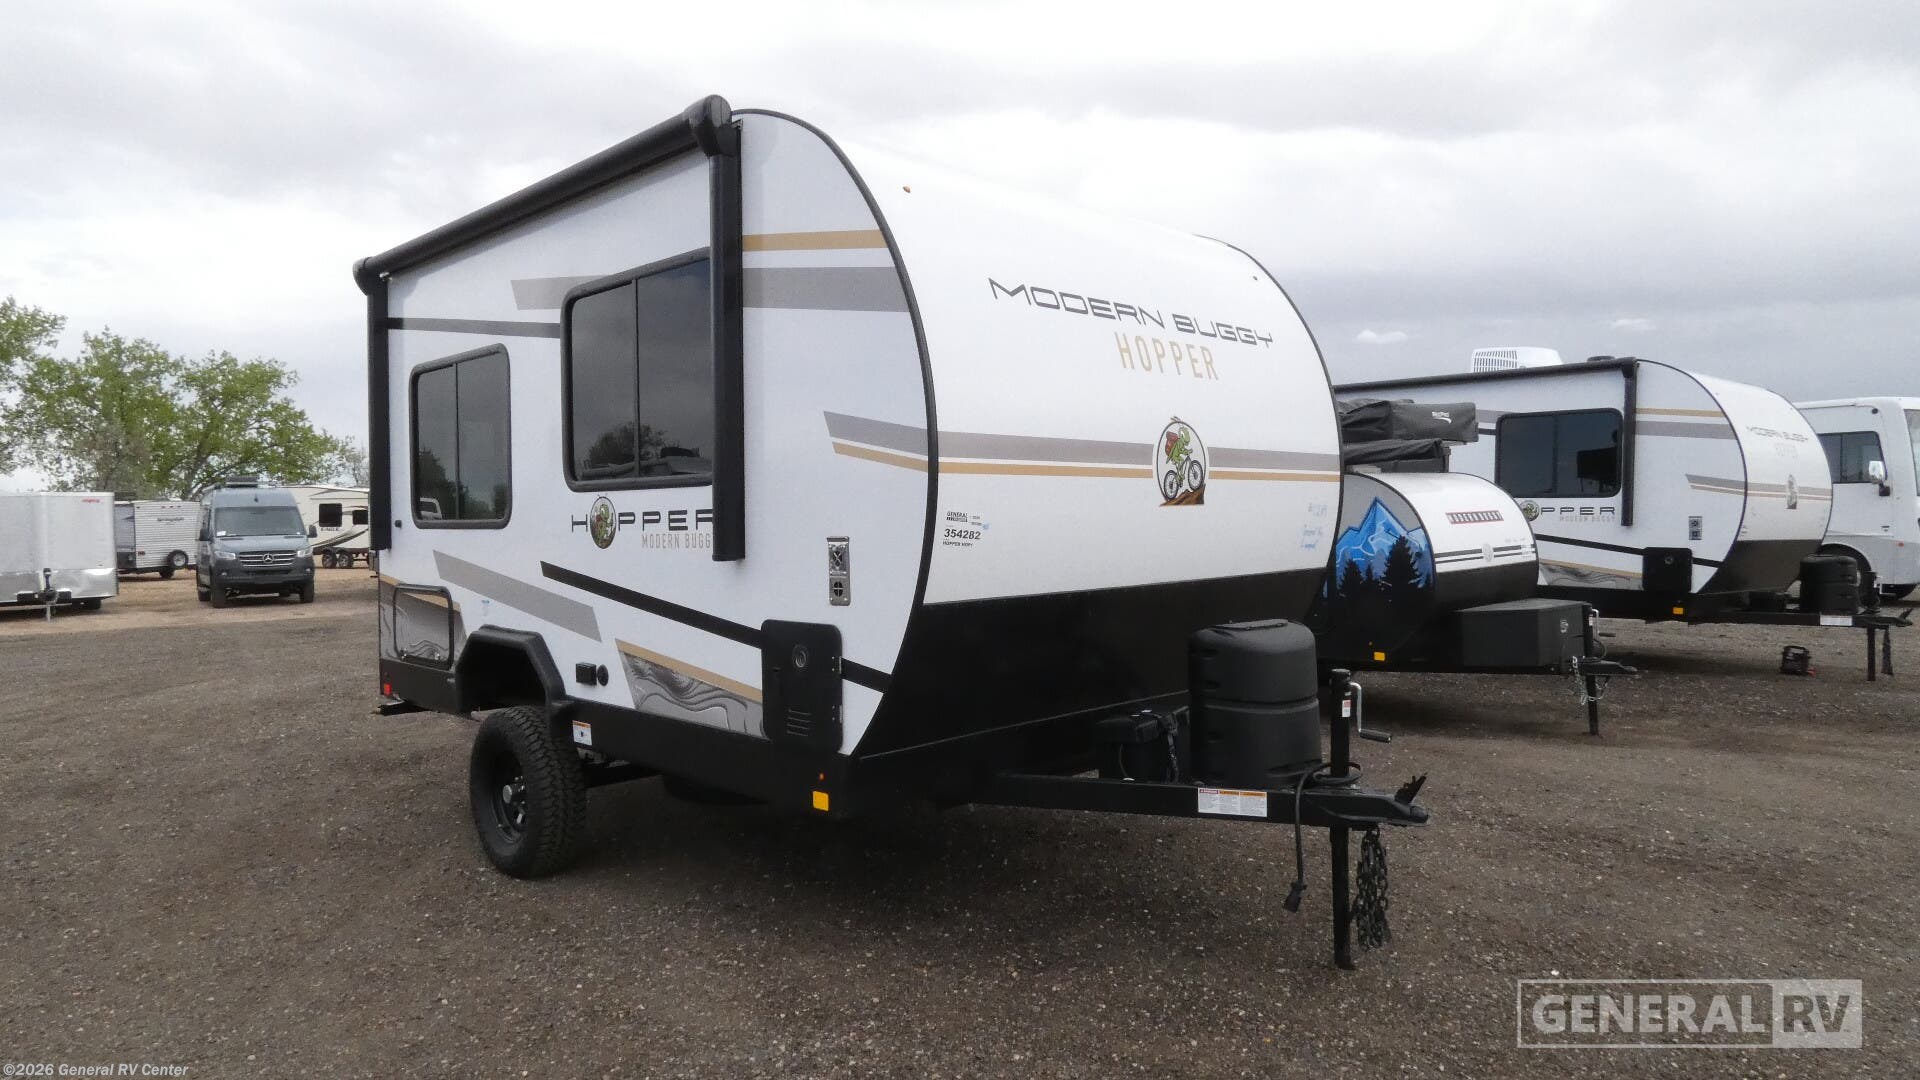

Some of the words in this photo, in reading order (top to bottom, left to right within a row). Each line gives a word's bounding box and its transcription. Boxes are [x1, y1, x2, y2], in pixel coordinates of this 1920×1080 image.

[988, 277, 1165, 329] MODERN
[1172, 313, 1273, 348] BUGGY
[1114, 331, 1219, 381] HOPPER
[642, 533, 680, 549] MODERN
[685, 533, 712, 549] BUGG
[944, 529, 981, 540] 354282
